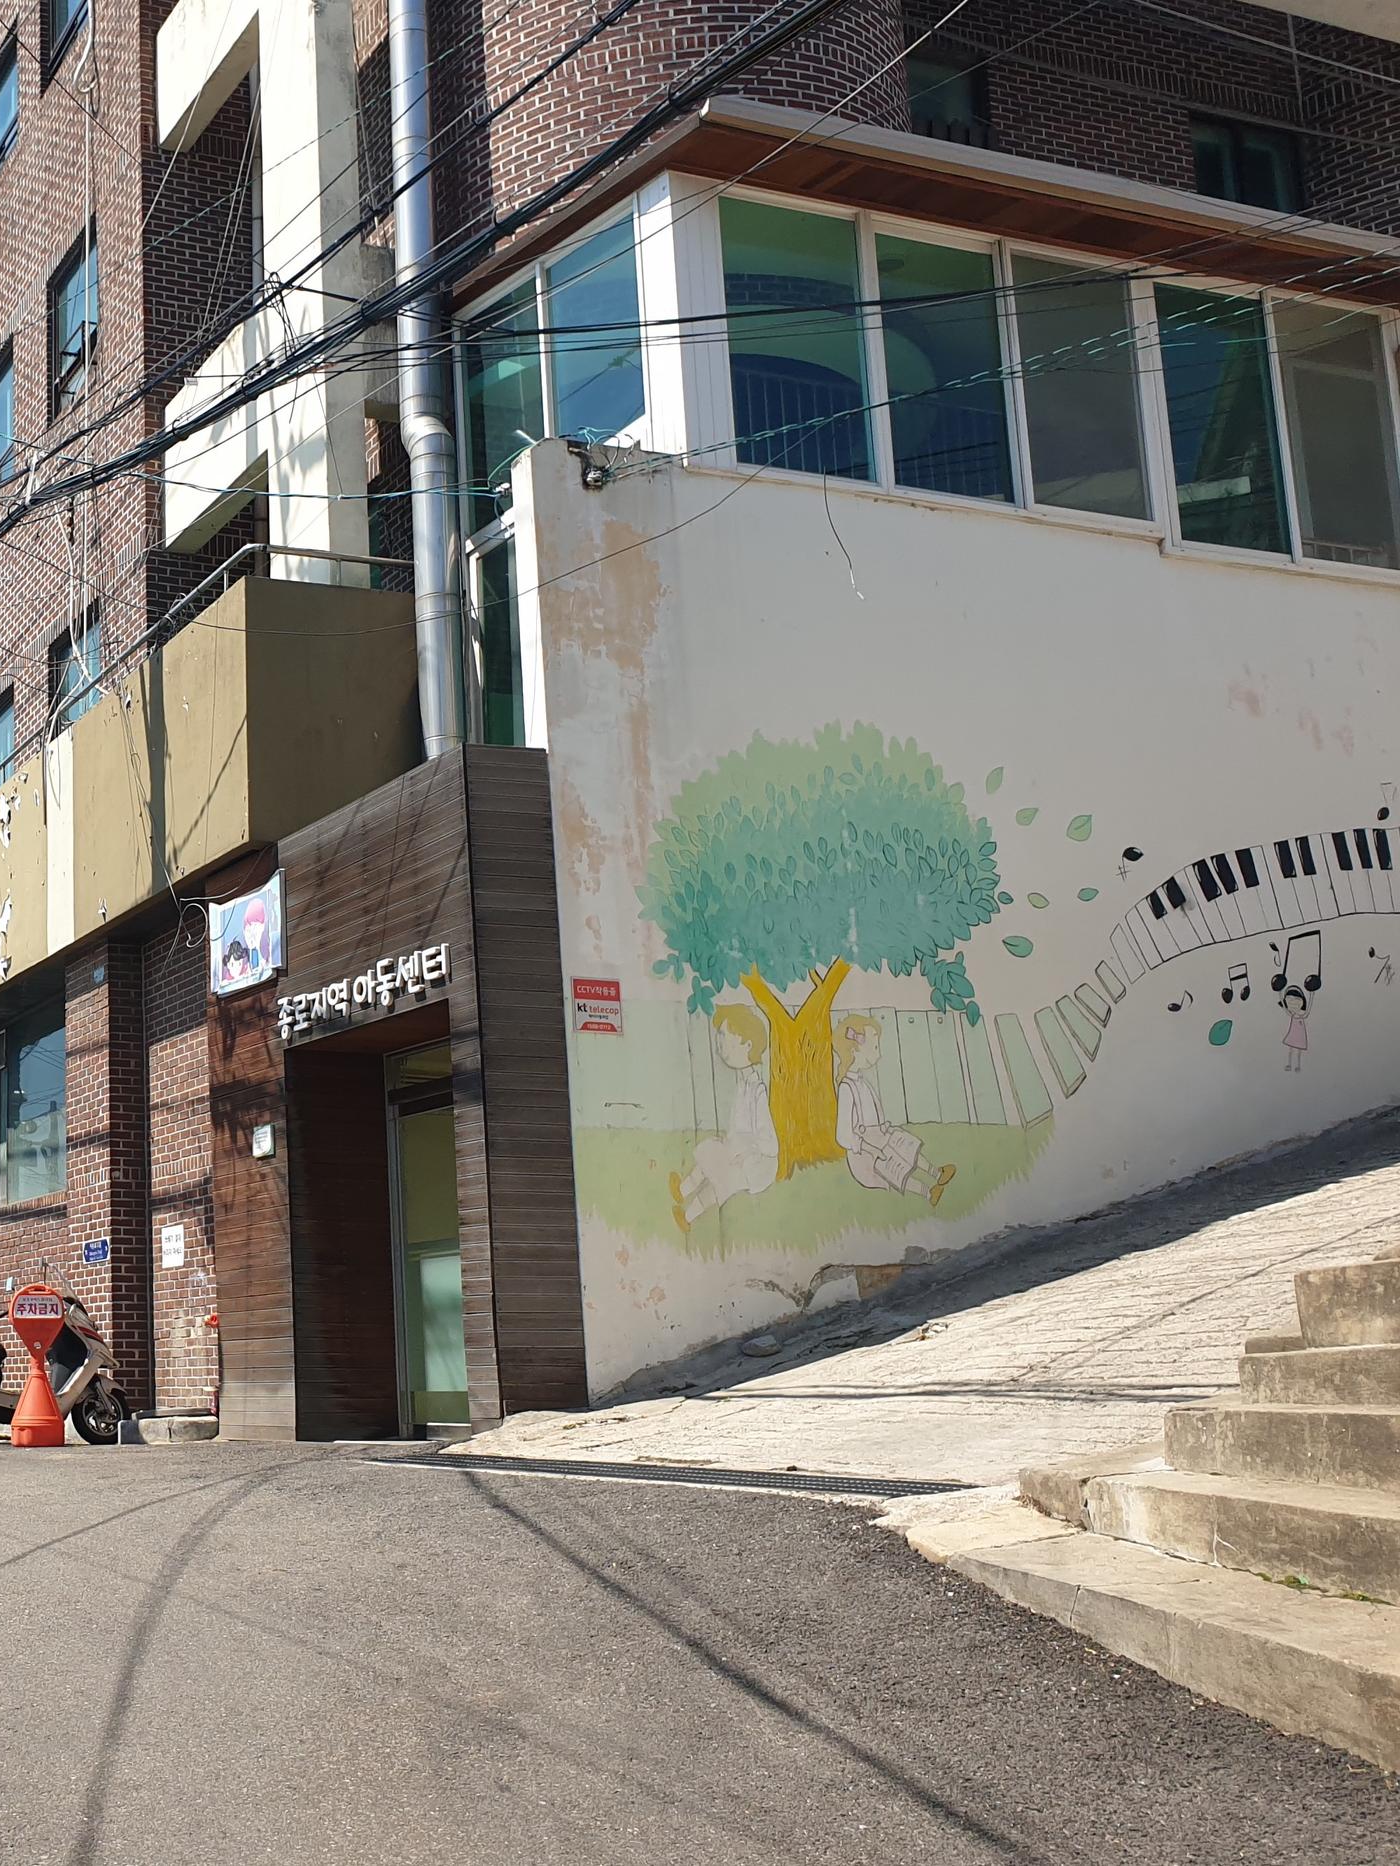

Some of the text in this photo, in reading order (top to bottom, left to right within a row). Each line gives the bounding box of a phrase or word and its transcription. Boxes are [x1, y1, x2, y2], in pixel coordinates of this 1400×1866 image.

[277, 943, 450, 1040] 종로지역 아동센터
[577, 1002, 619, 1015] kt telecop
[17, 1302, 59, 1316] 주차금지
